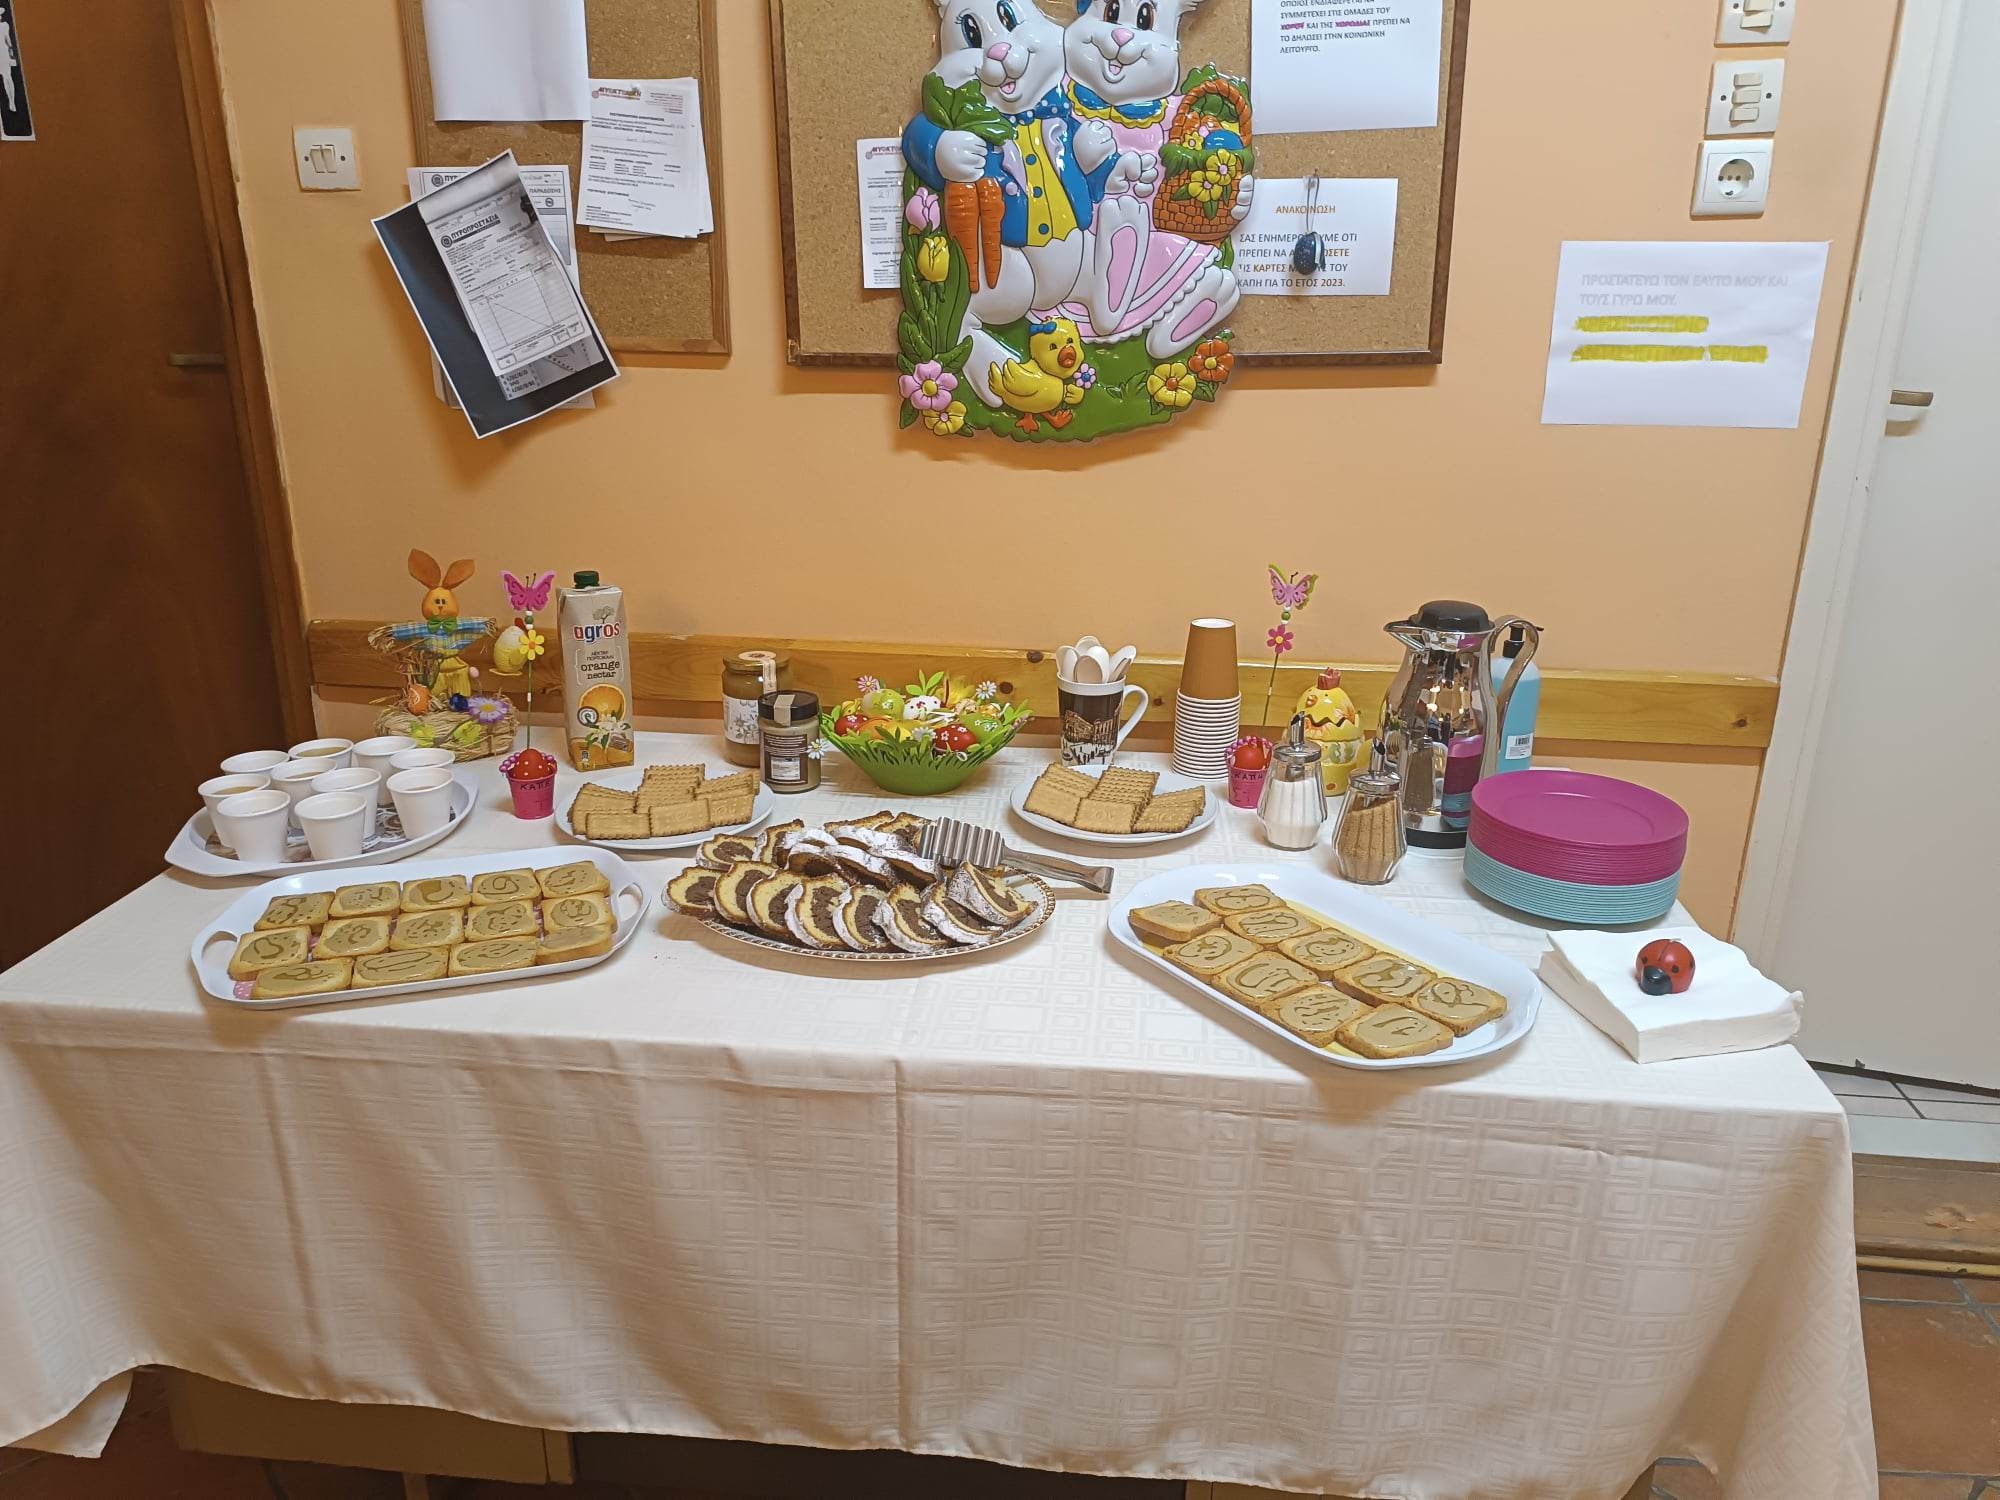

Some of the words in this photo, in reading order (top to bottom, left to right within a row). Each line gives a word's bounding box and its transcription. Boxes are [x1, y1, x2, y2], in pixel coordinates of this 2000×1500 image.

[1281, 10, 1326, 19] ΣΥΜΜΕΤΕΧΕΙ
[1343, 8, 1374, 16] ΟΜΑΔΕΣ
[1373, 18, 1398, 26] ΠΡΕΠΕΙ
[1400, 17, 1411, 25] ΝΑ
[1291, 33, 1322, 41] ΔΗΛΩΣΕΙ
[1324, 32, 1342, 40] ΣΤΗΝ
[1344, 30, 1385, 39] ΚΟΙΝΩΝΙΚΗ
[1240, 233, 1256, 243] ΣΑΣ
[1341, 233, 1358, 242] ΟΤΙ
[1239, 248, 1271, 258] ΠΡΕΠΕΙ
[1273, 248, 1287, 257] ΝΑ
[1253, 264, 1286, 272] ΚΑΡΤΕΣ
[1329, 263, 1348, 272] ΤΟΥ
[1237, 278, 1262, 288] ΚΑΠΗ
[1264, 279, 1278, 287] ΓΙΑ
[1281, 279, 1293, 288] ΤΟ
[1295, 279, 1319, 288] ΕΤΟΣ
[1320, 278, 1346, 287] 2023.
[1581, 274, 1661, 287] ΠΡΟΣΤΑΤΕΥΩ
[1663, 274, 1690, 287] ΤΟΝ
[1692, 275, 1733, 287] ΕΑΥΤΟ
[1734, 275, 1768, 288] ΜΟΥ
[1768, 275, 1788, 287] ΚΑΙ
[1579, 293, 1610, 305] ΤΟΥΣ
[1611, 294, 1643, 305] ΓΥΡΩ
[573, 622, 620, 643] agros
[580, 660, 621, 672] orange
[587, 671, 617, 680] nectar
